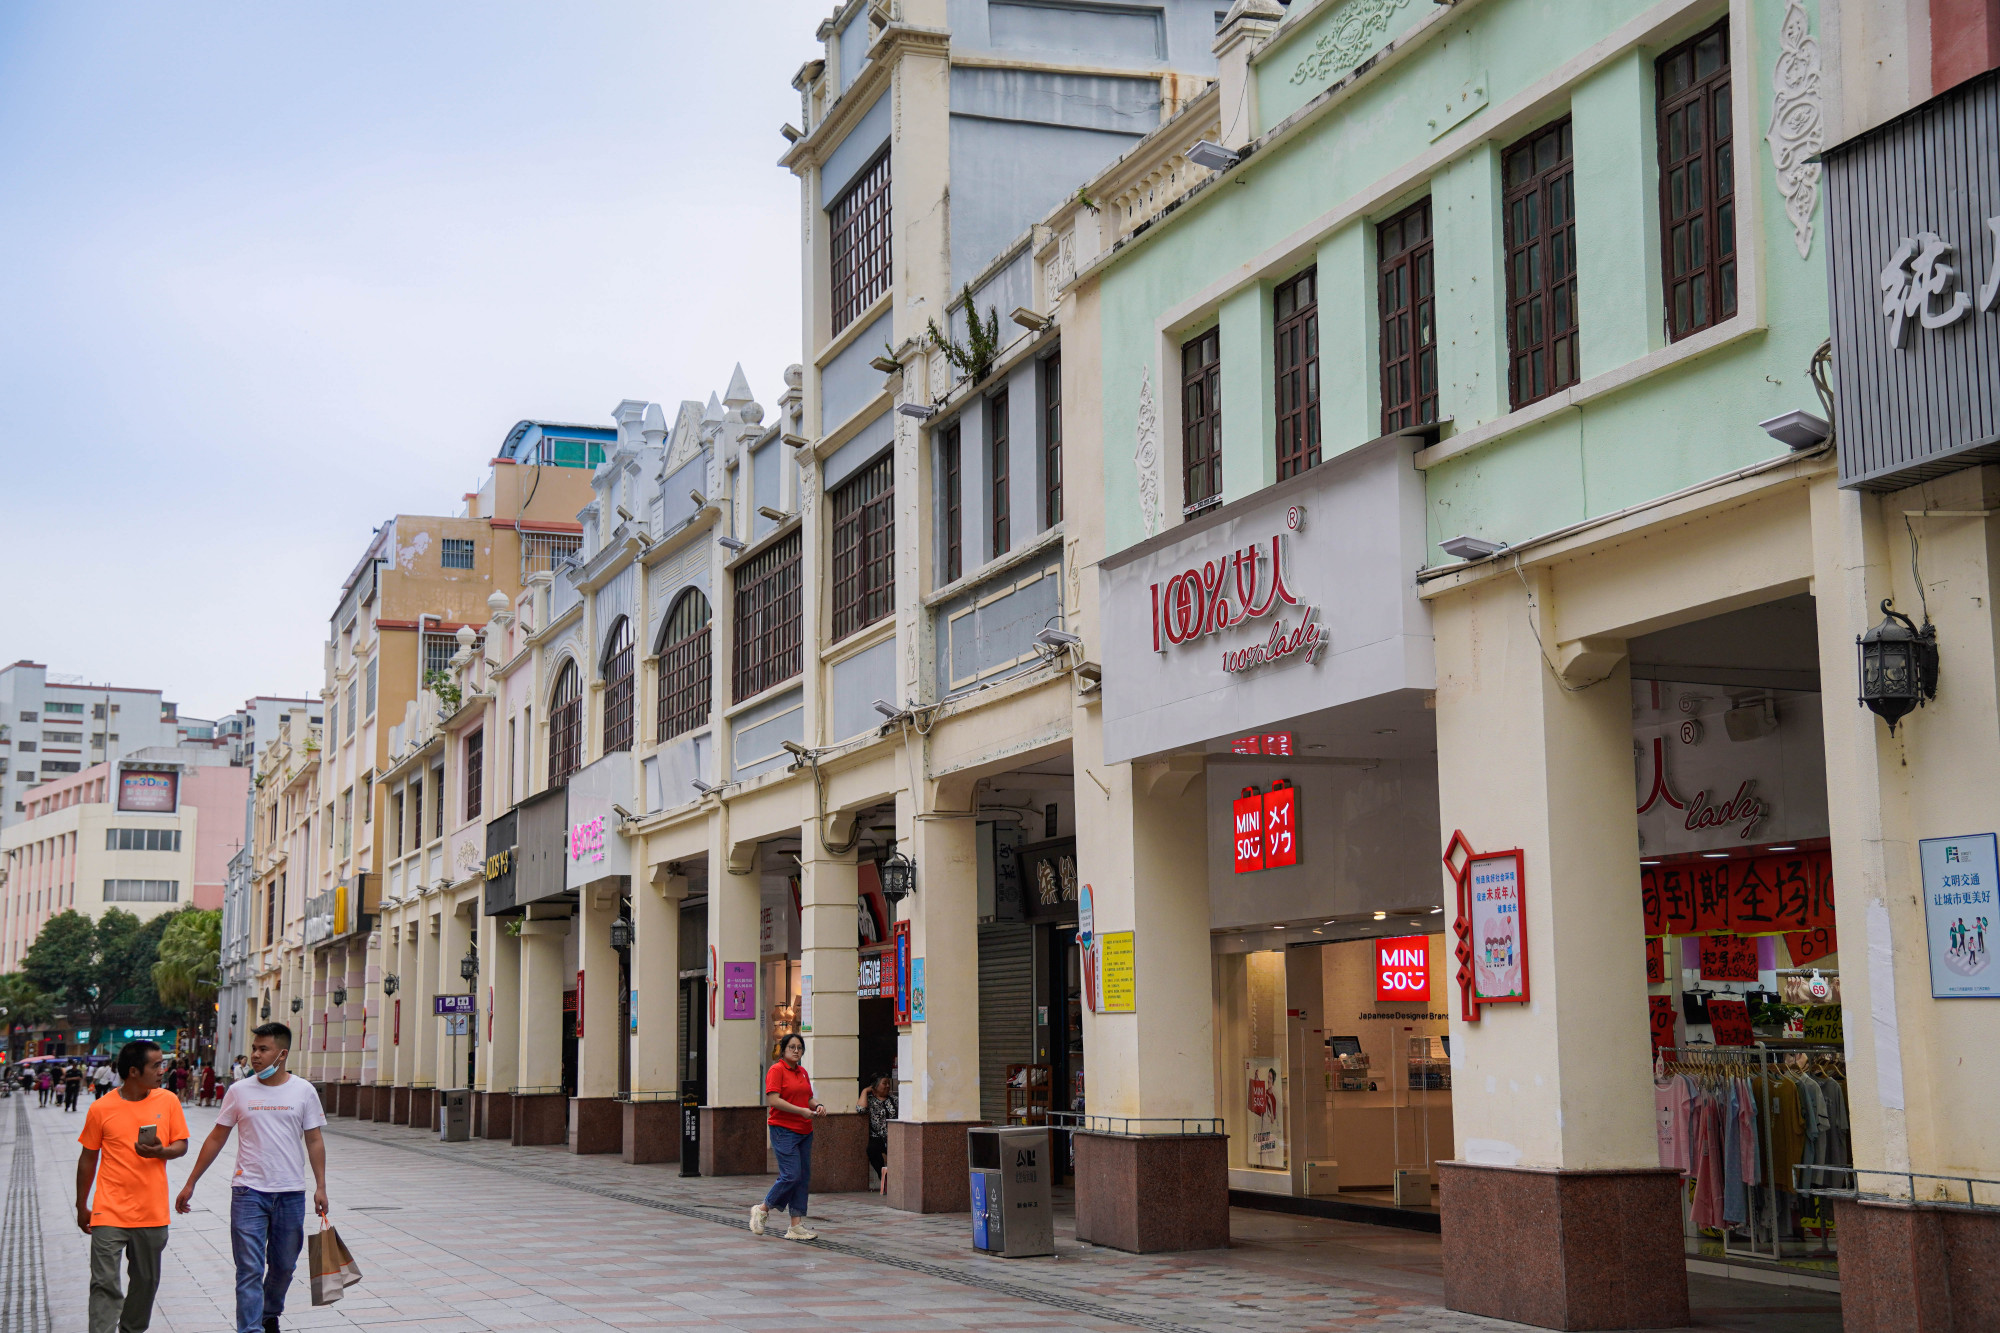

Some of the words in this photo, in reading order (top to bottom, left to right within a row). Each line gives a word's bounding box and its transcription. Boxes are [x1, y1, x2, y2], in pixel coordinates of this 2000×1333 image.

[1269, 802, 1290, 830] メイ
[1684, 781, 1760, 839] lady
[1236, 811, 1260, 834] MINI
[1270, 830, 1291, 856] ソウ
[1942, 873, 1981, 888] 文明交通
[1476, 885, 1517, 901] 促进未成年人
[1934, 890, 1991, 906] 让城市更美好
[1497, 903, 1517, 914] 健康成长
[1800, 928, 1829, 956] 69
[1381, 949, 1424, 966] MINI
[1812, 984, 1826, 995] 69
[1359, 1012, 1395, 1020] Japanese
[1395, 1012, 1428, 1021] Designer
